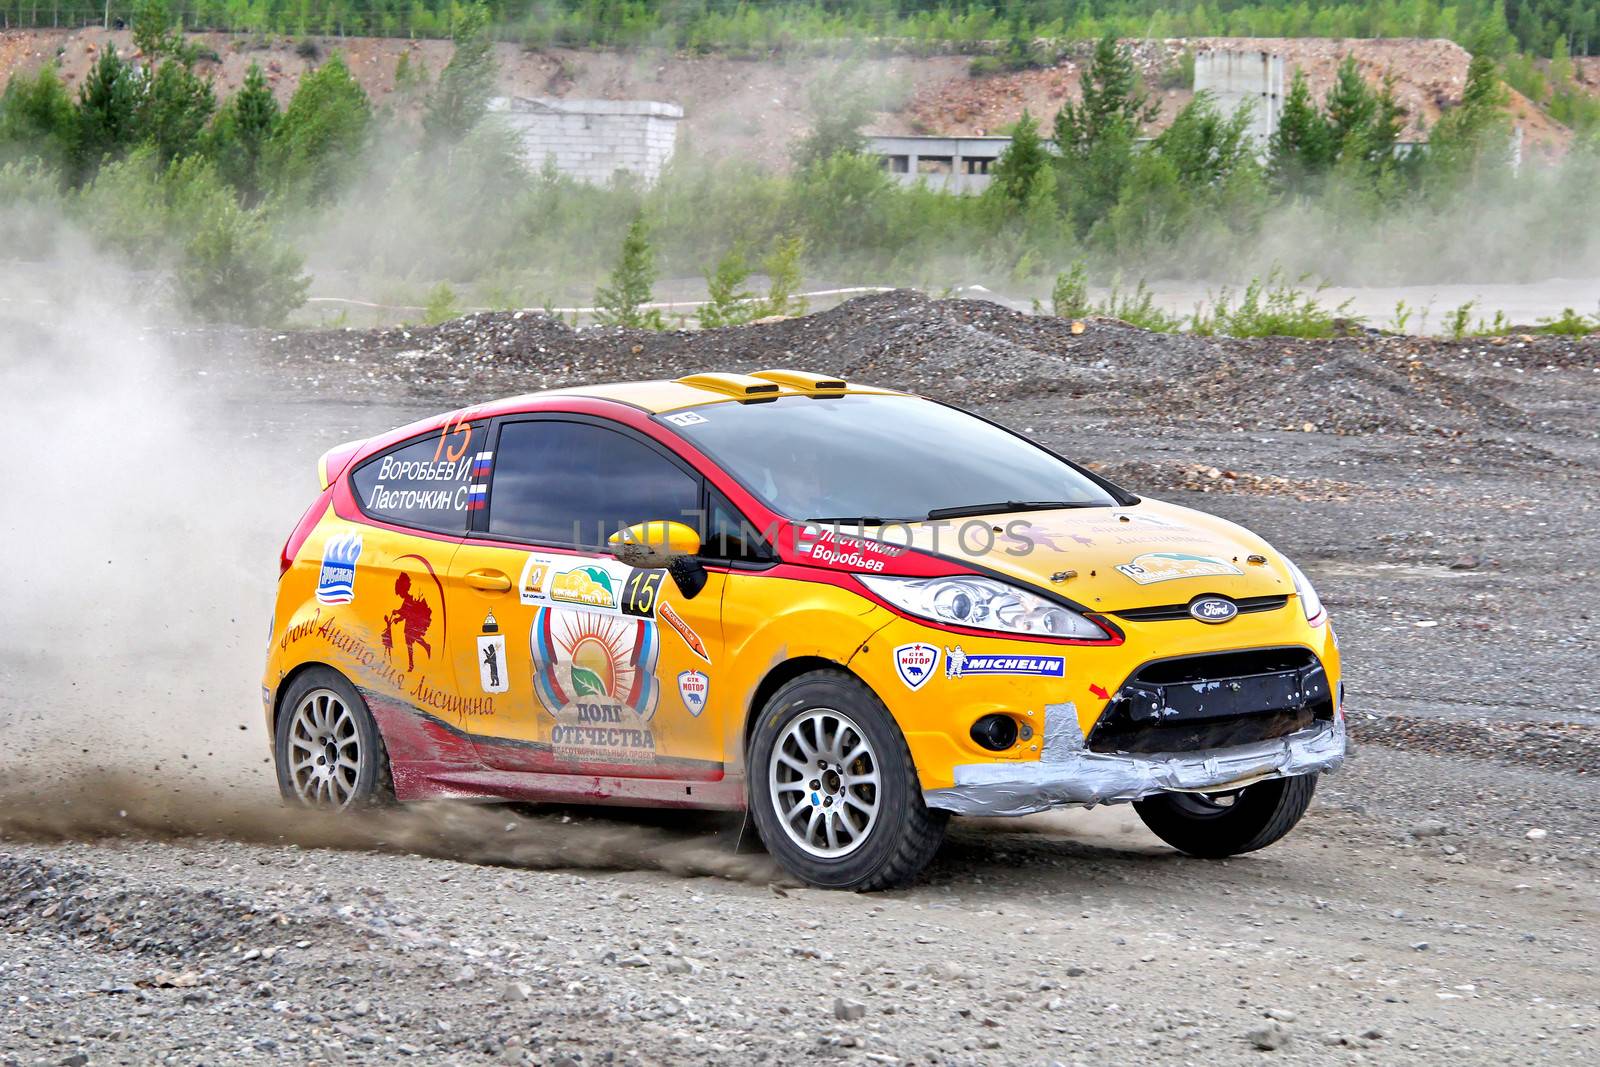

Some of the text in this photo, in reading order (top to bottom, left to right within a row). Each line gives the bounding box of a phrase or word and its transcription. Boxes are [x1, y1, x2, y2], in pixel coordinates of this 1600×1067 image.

[673, 413, 701, 424] 15
[433, 408, 480, 463] 15
[455, 455, 474, 482] И.
[366, 484, 470, 511] Ласточкин С.
[820, 528, 904, 558] Ласточкин
[812, 544, 885, 572] Воробьев
[1120, 563, 1146, 575] 15
[630, 571, 661, 613] 15
[1203, 602, 1229, 616] Ford
[902, 657, 930, 666] МОТОР
[968, 658, 1061, 671] MICHELIN
[576, 703, 622, 725] ДОЛГ
[552, 725, 655, 749] ОТЕЧЕСТВА
